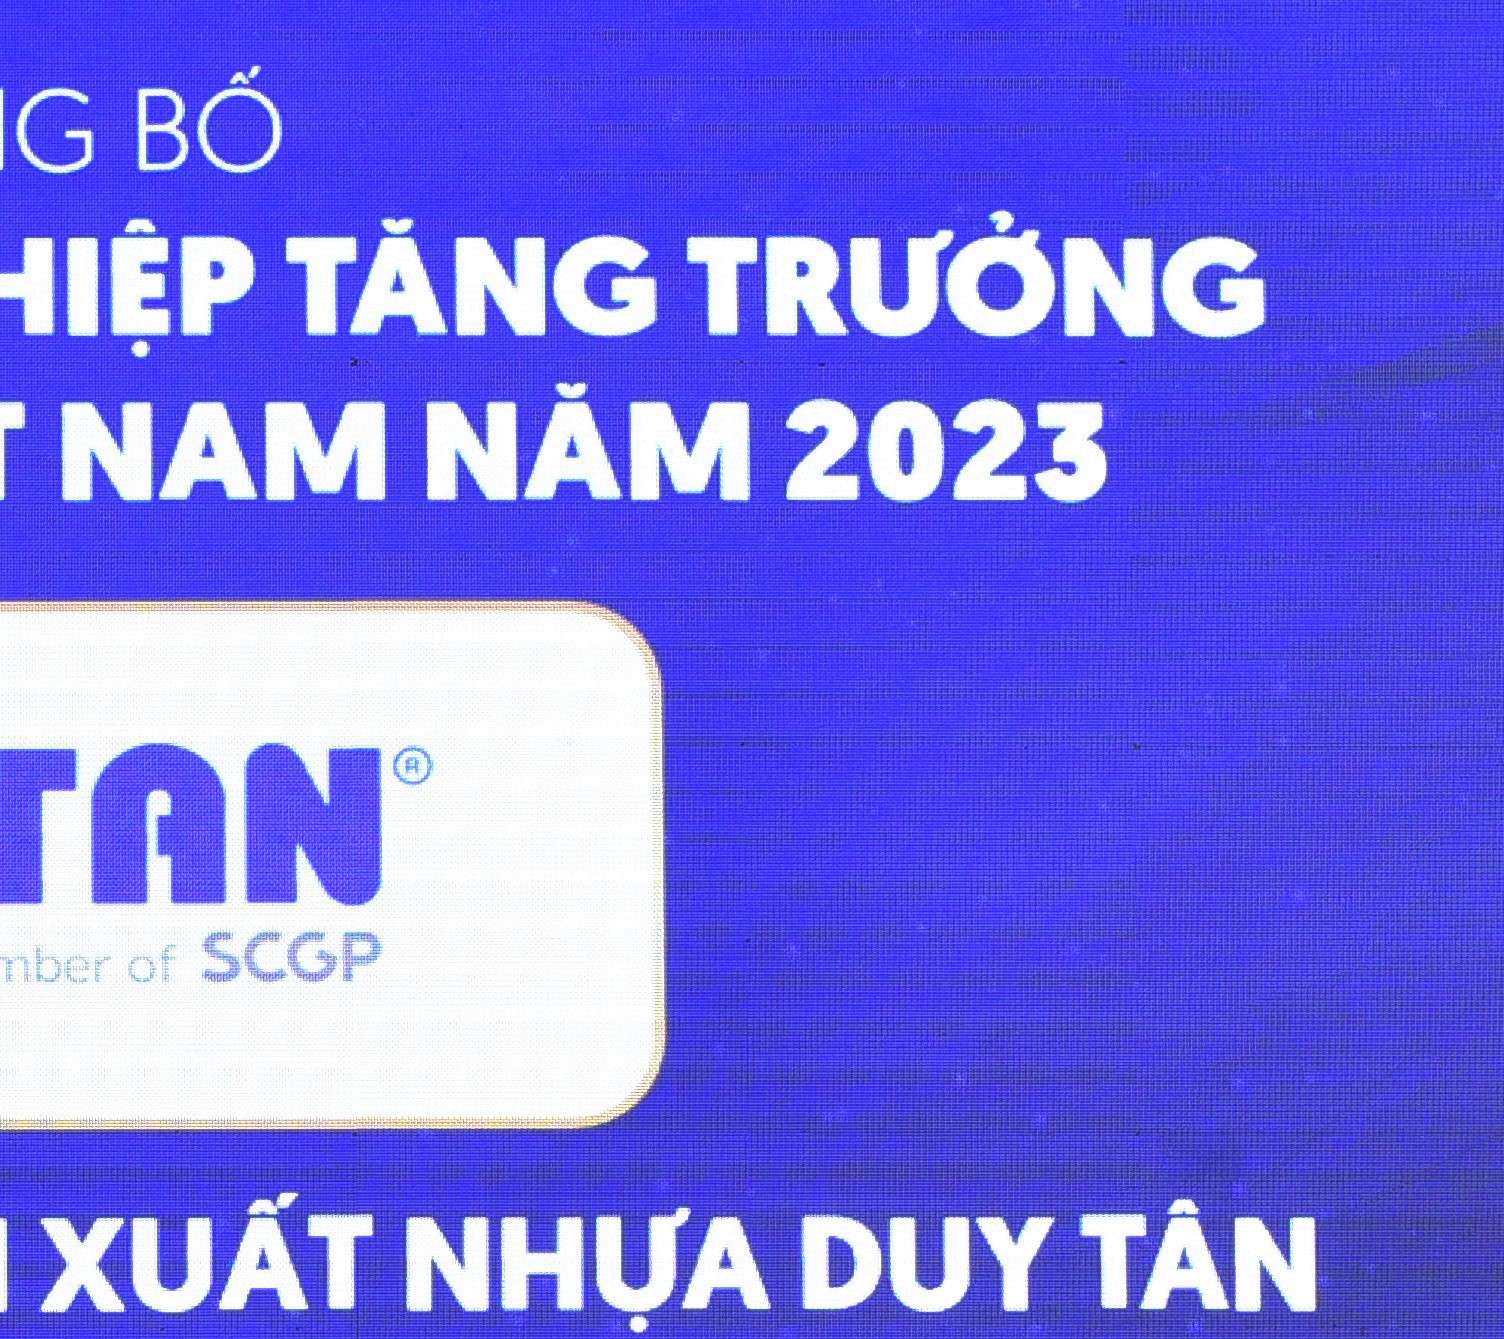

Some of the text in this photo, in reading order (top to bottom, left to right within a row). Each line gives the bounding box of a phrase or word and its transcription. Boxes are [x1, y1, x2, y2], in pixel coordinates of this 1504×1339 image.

[137, 65, 283, 174] BỐ
[286, 218, 656, 336] TĂNG
[687, 210, 1265, 337] TRƯỞNG
[62, 402, 386, 501] NAM
[426, 383, 750, 501] NĂM
[786, 399, 1107, 502] 2023
[128, 943, 178, 984] of
[201, 929, 384, 984] SCGP
[41, 1192, 373, 1313] XUẤT
[406, 1207, 770, 1333] NHỰA
[802, 1215, 1054, 1313] DUY
[1081, 1199, 1317, 1312] TÂN
